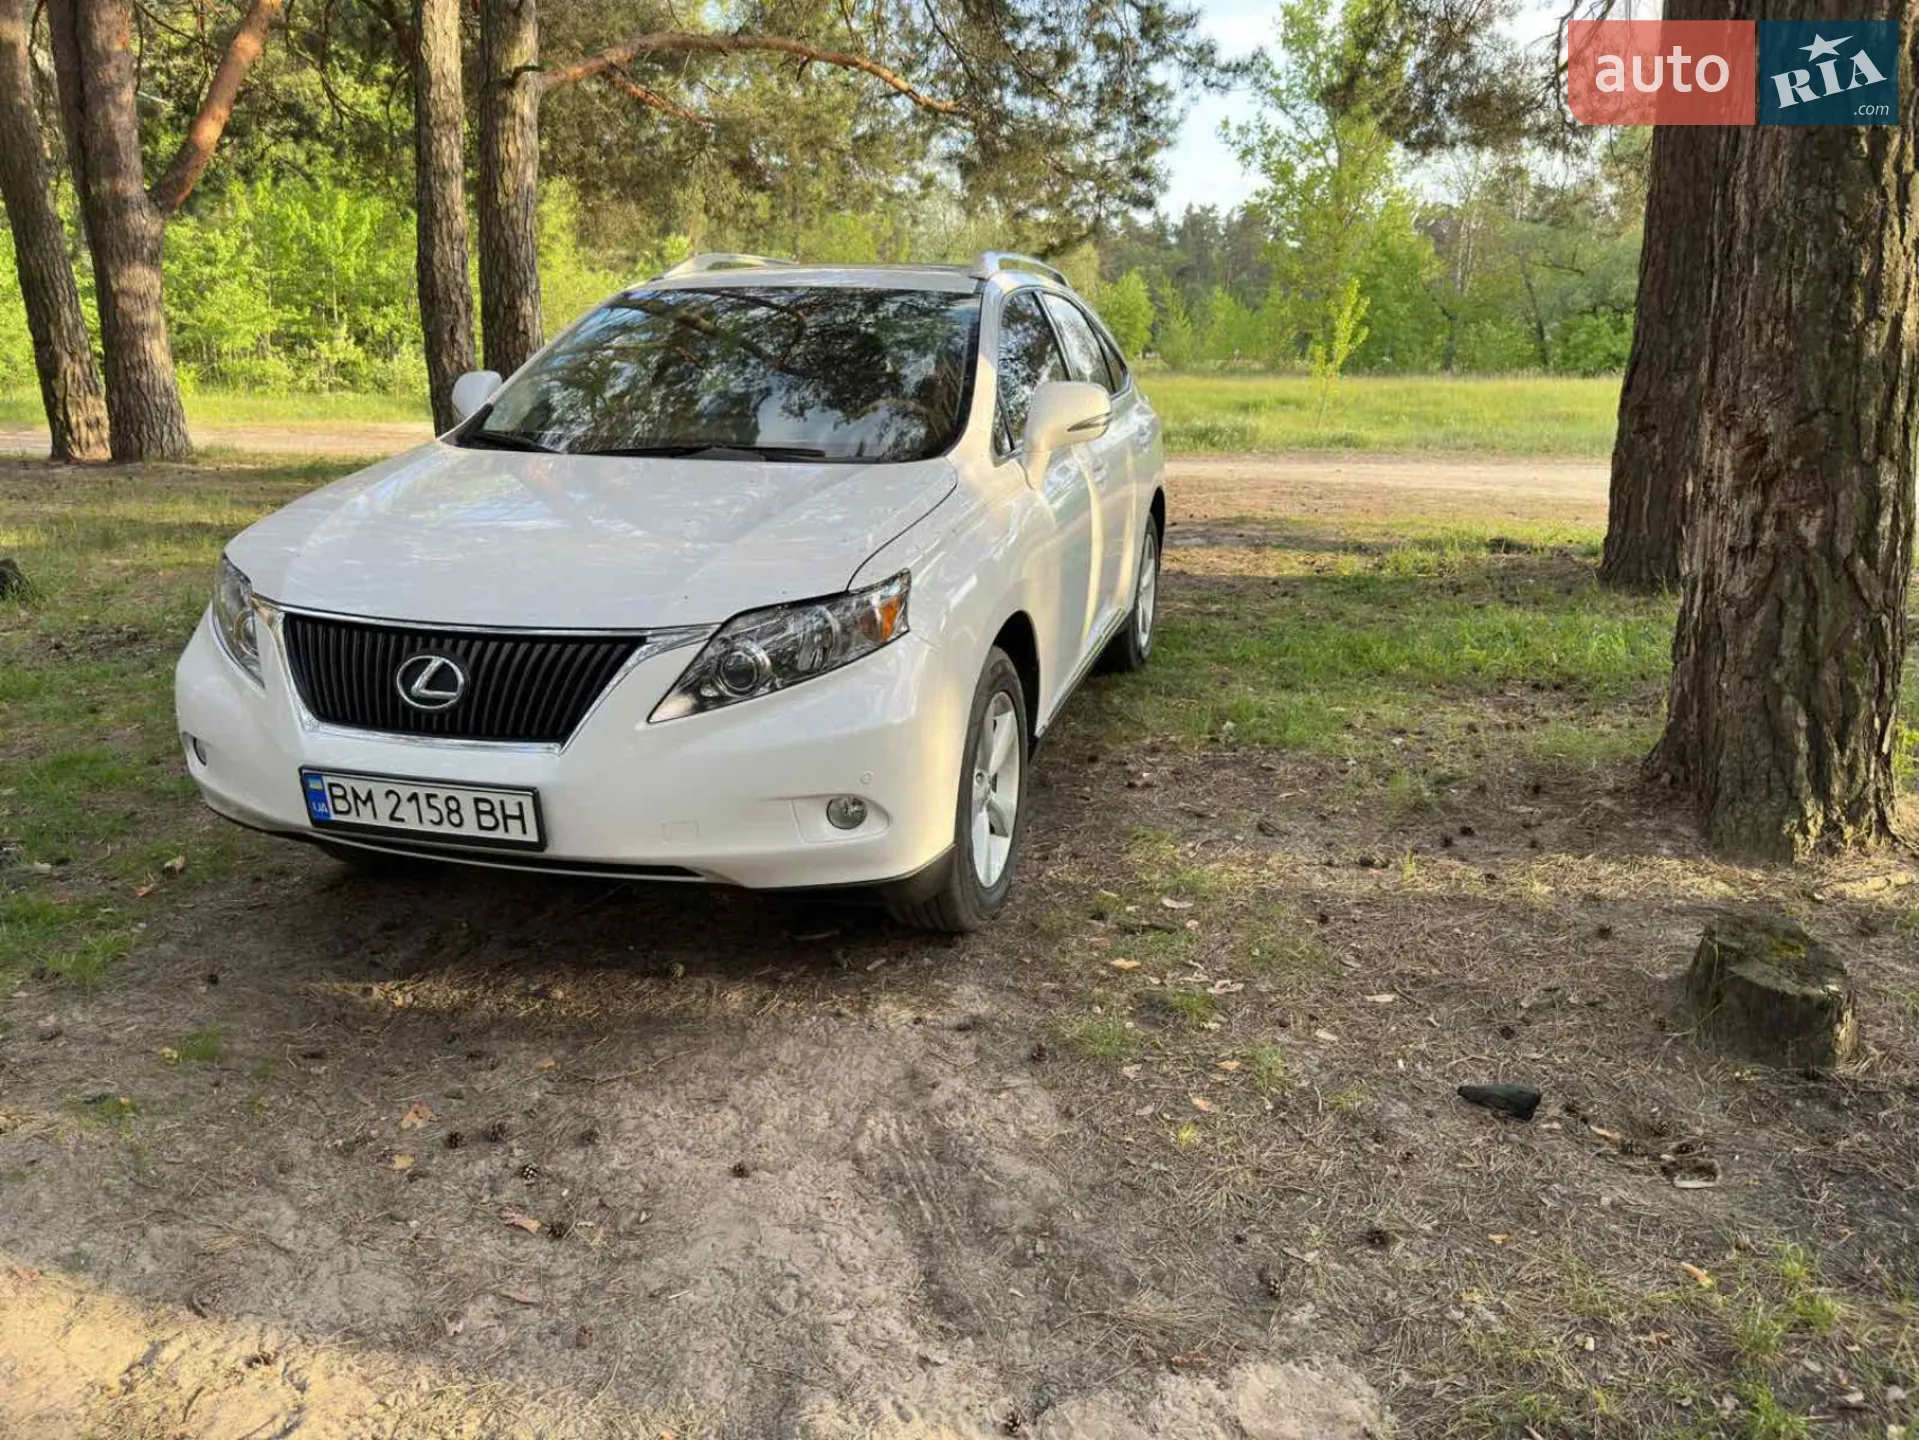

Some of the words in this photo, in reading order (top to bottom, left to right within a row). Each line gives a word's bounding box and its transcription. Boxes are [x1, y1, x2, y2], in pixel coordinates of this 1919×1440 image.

[312, 801, 328, 813] UA
[327, 782, 377, 820] BM
[385, 789, 464, 828] 2158
[473, 797, 528, 835] BH
